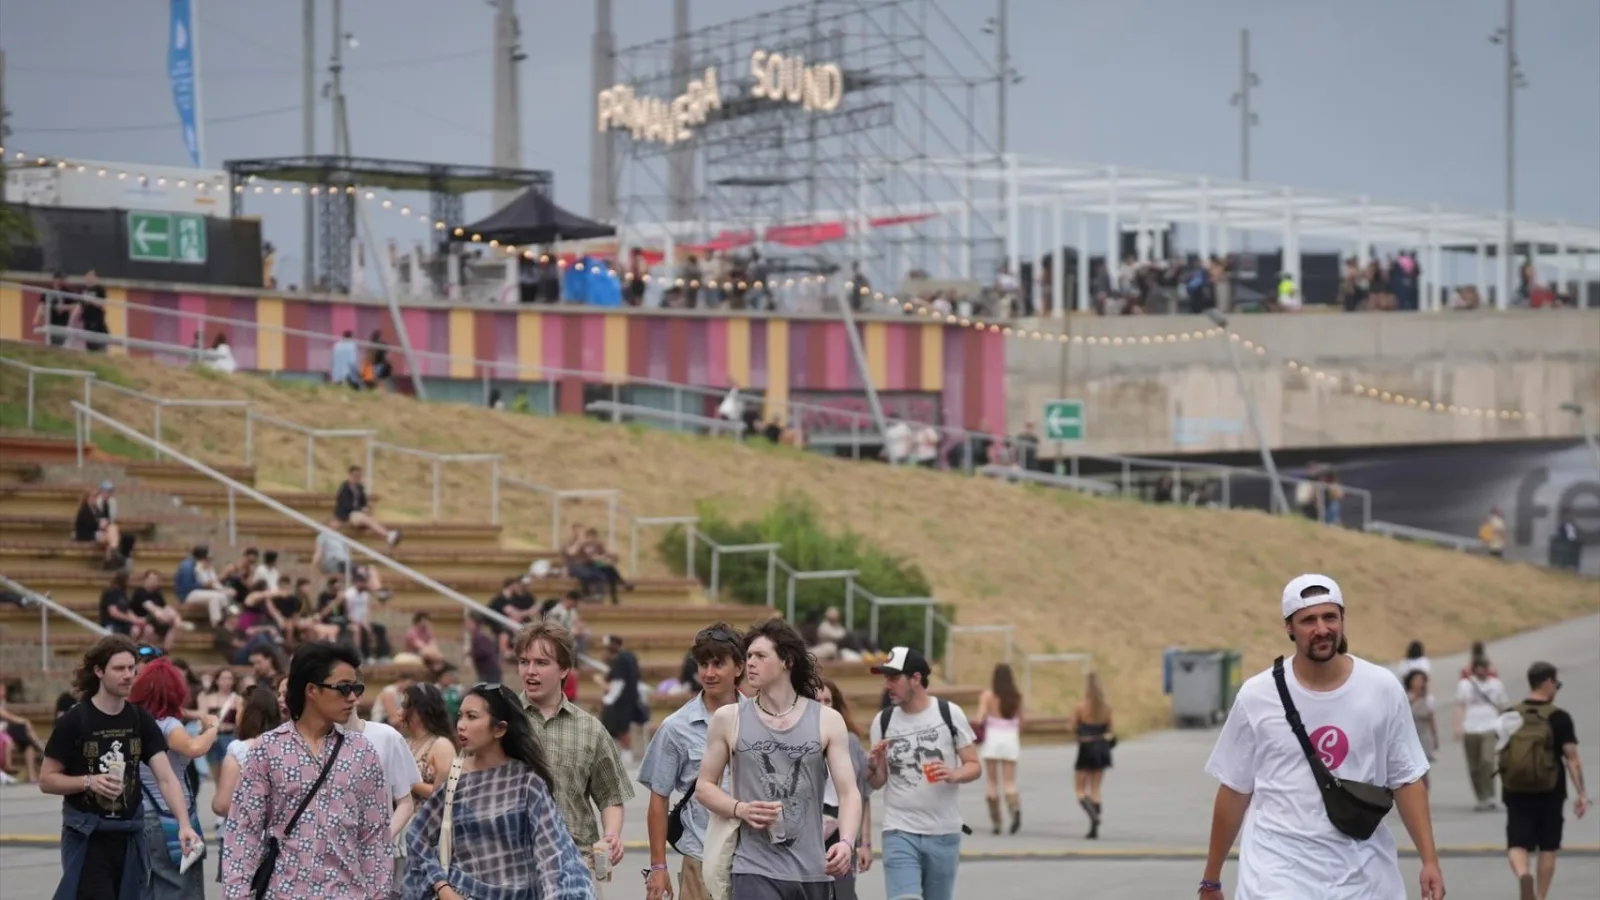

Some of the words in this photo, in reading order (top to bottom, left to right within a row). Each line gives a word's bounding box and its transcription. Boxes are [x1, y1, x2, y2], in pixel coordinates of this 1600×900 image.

[598, 65, 721, 145] PRIMAVERA
[750, 49, 843, 112] SOUND
[764, 740, 822, 759] Hardy
